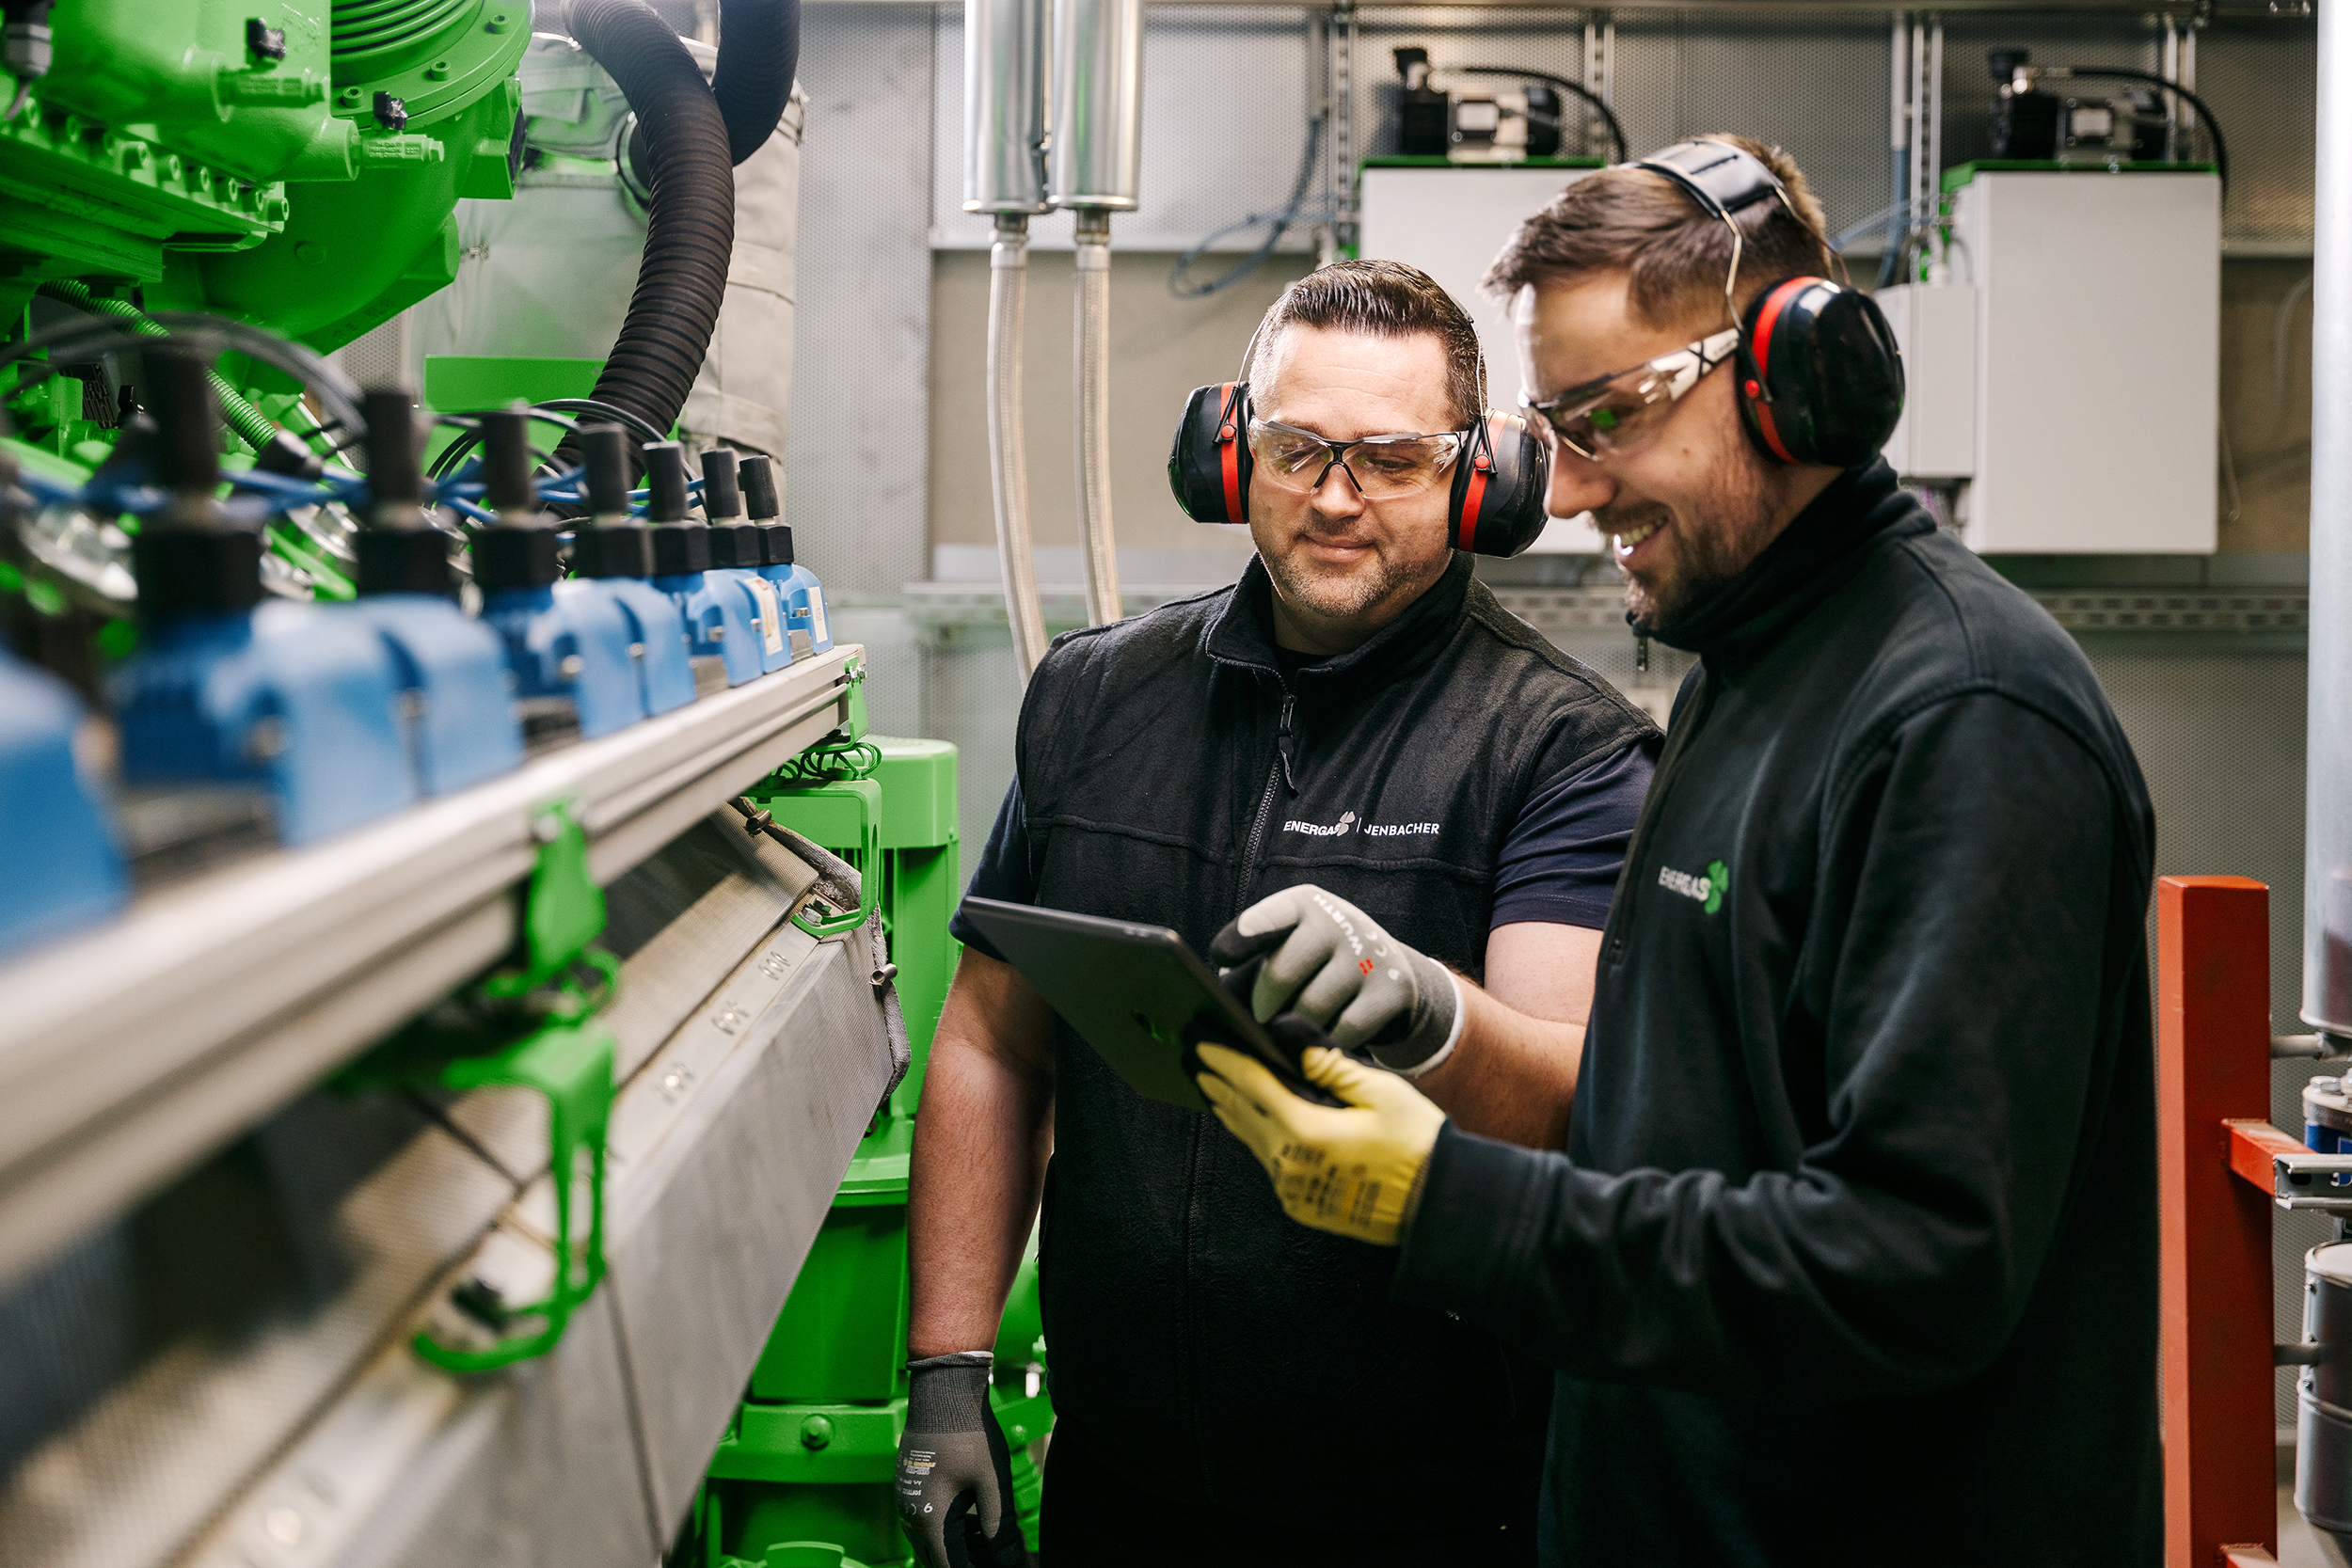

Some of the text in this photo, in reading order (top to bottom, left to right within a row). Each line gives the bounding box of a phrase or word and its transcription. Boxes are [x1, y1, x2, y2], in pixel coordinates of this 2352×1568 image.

[1282, 820, 1440, 836] ENERGAS JENBACHER
[1658, 865, 1711, 902] ENERGAS
